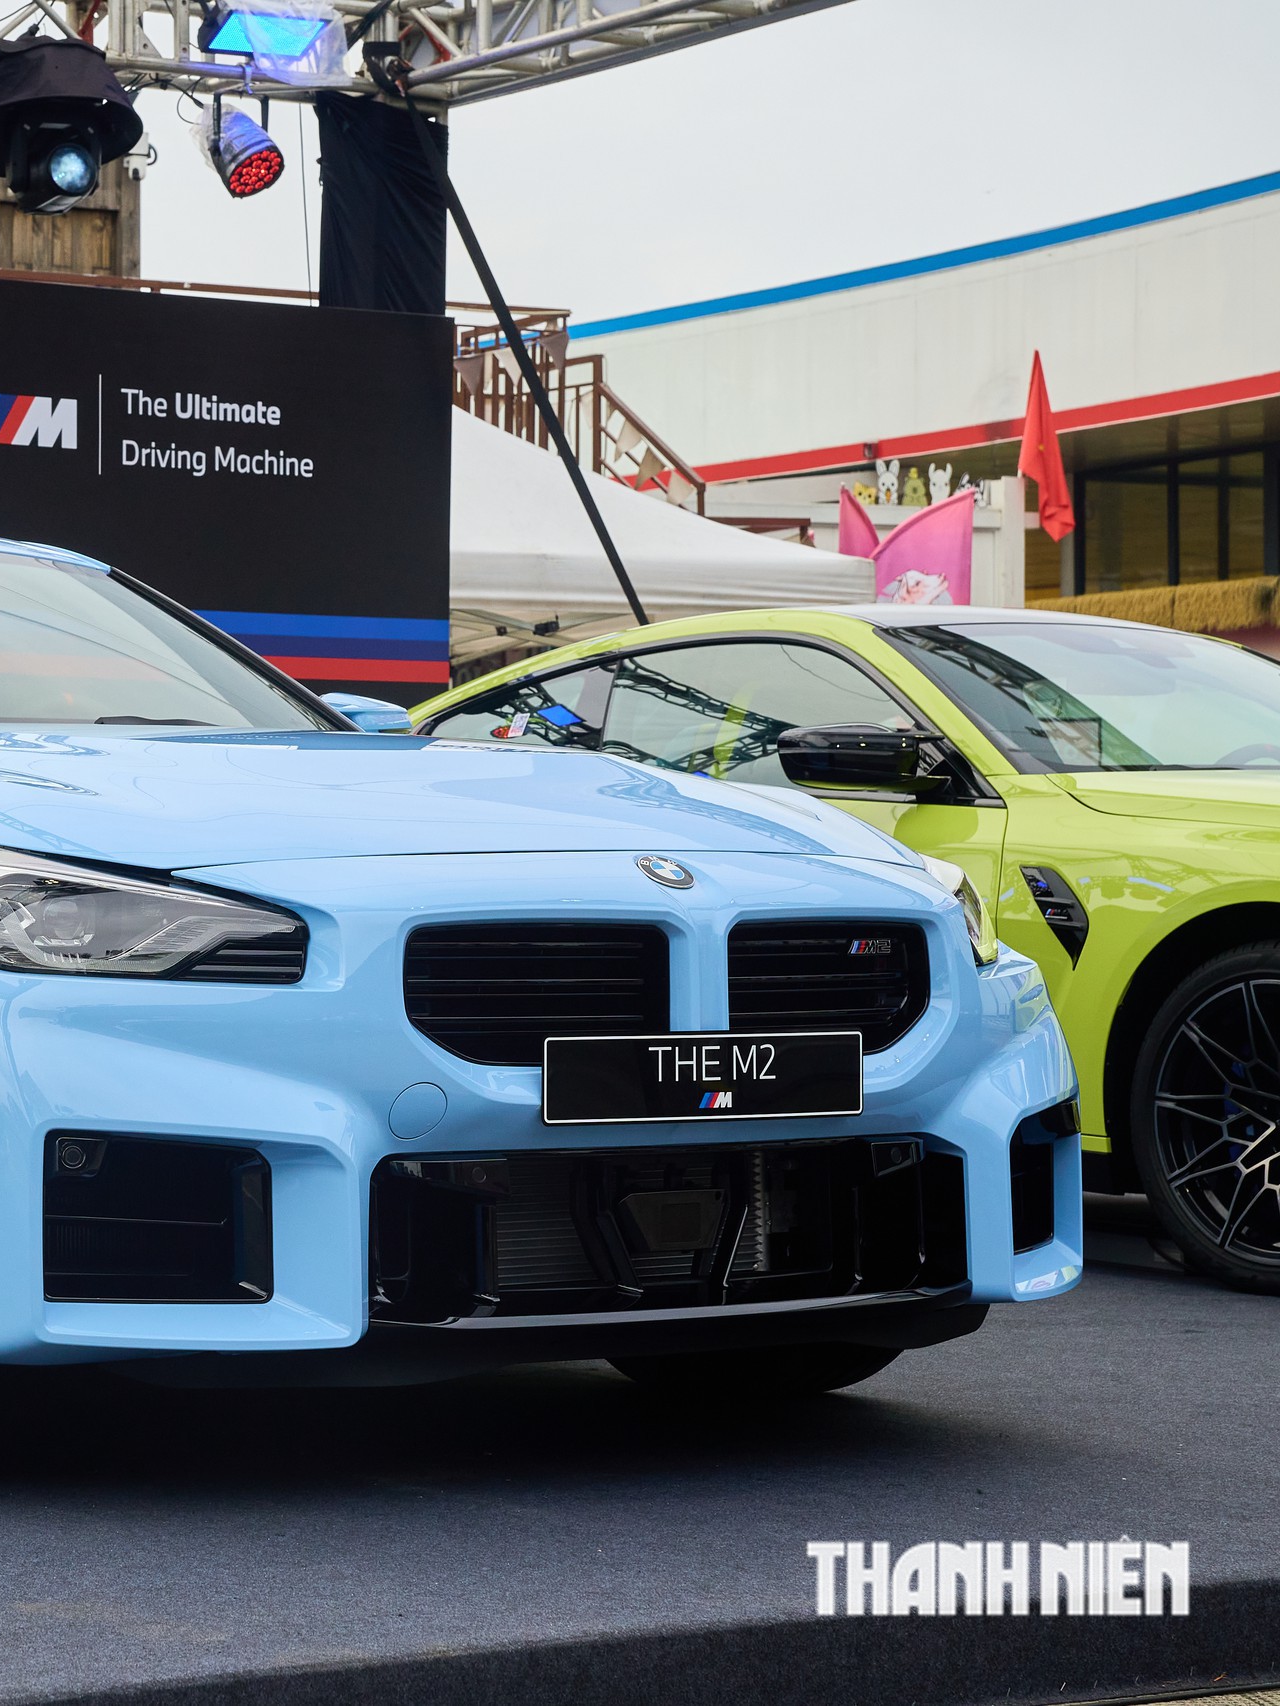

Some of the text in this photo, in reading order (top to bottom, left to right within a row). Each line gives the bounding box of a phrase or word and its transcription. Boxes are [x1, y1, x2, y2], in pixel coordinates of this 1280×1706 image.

[10, 395, 78, 450] M
[121, 387, 281, 425] The Ultimate
[121, 440, 314, 477] Driving Machine
[648, 1043, 777, 1082] THE M2
